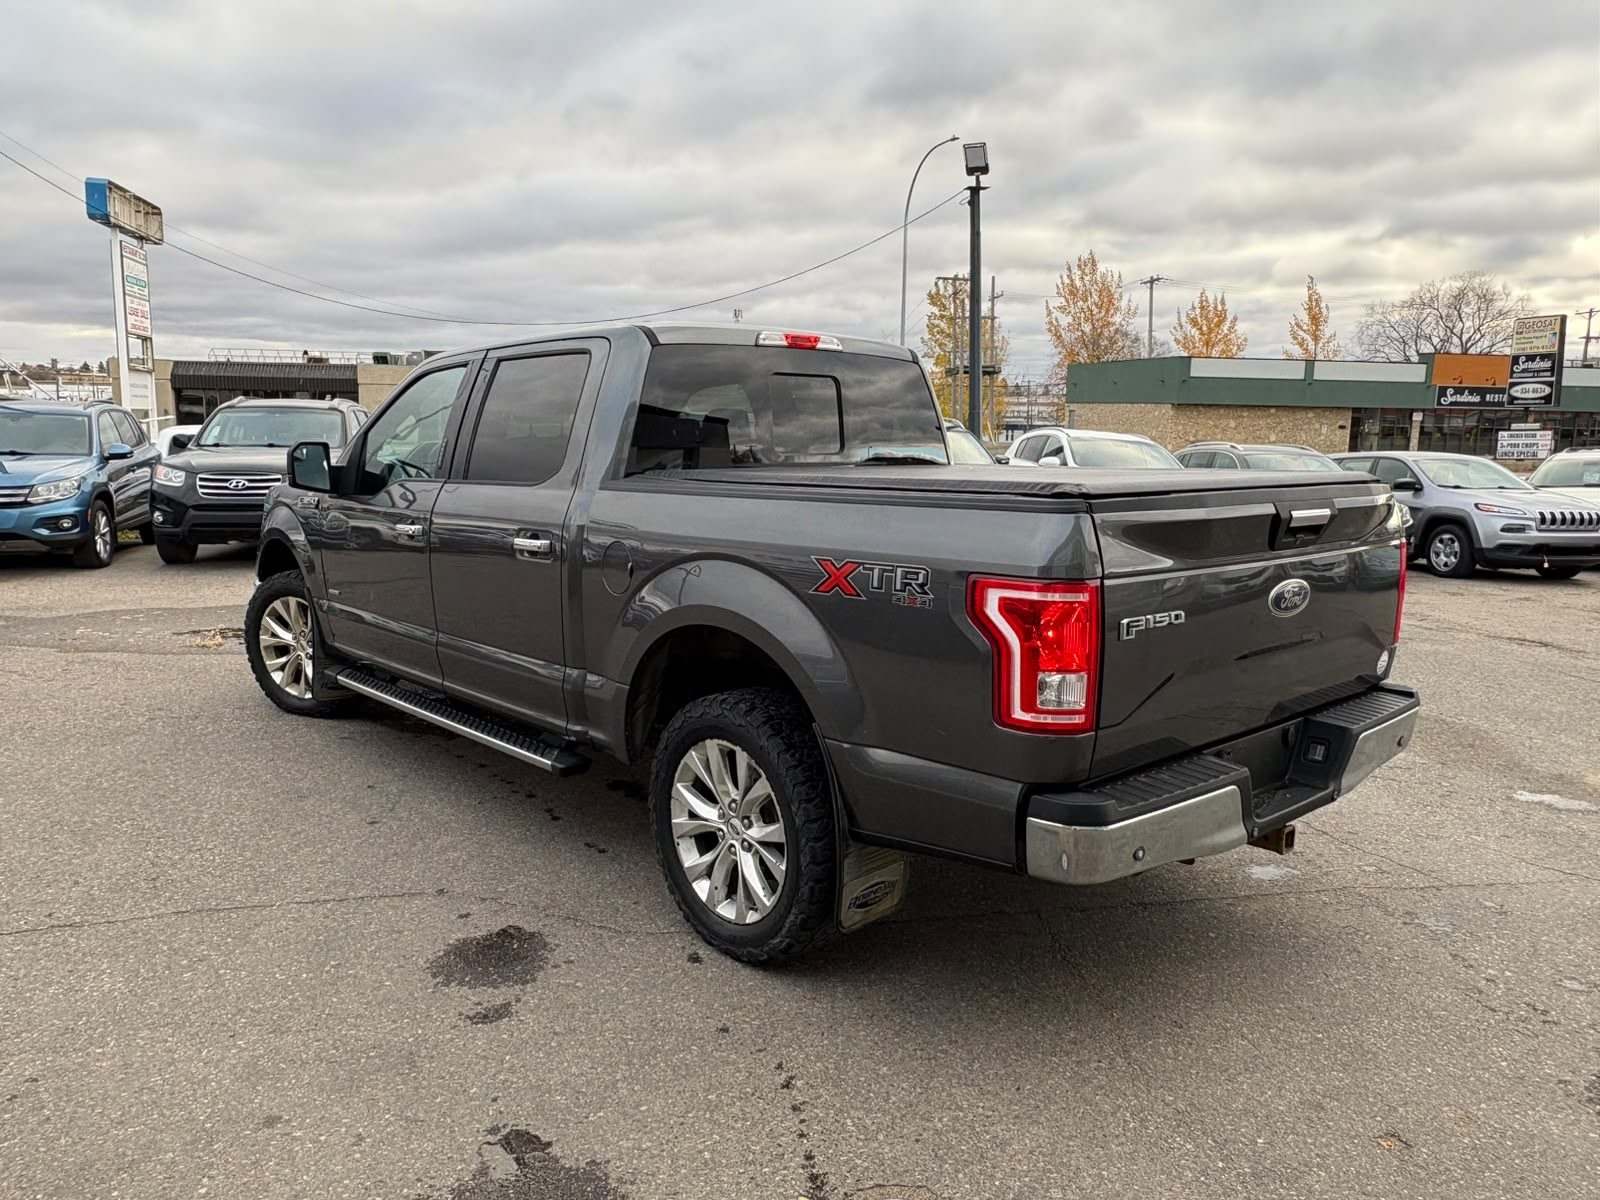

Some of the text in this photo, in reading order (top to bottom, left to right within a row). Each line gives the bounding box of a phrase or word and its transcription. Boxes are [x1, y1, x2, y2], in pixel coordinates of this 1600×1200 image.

[1524, 318, 1558, 330] GEOSAT
[1513, 356, 1552, 372] Sardinia
[1440, 388, 1482, 405] Sardinia
[808, 555, 935, 600] XTR
